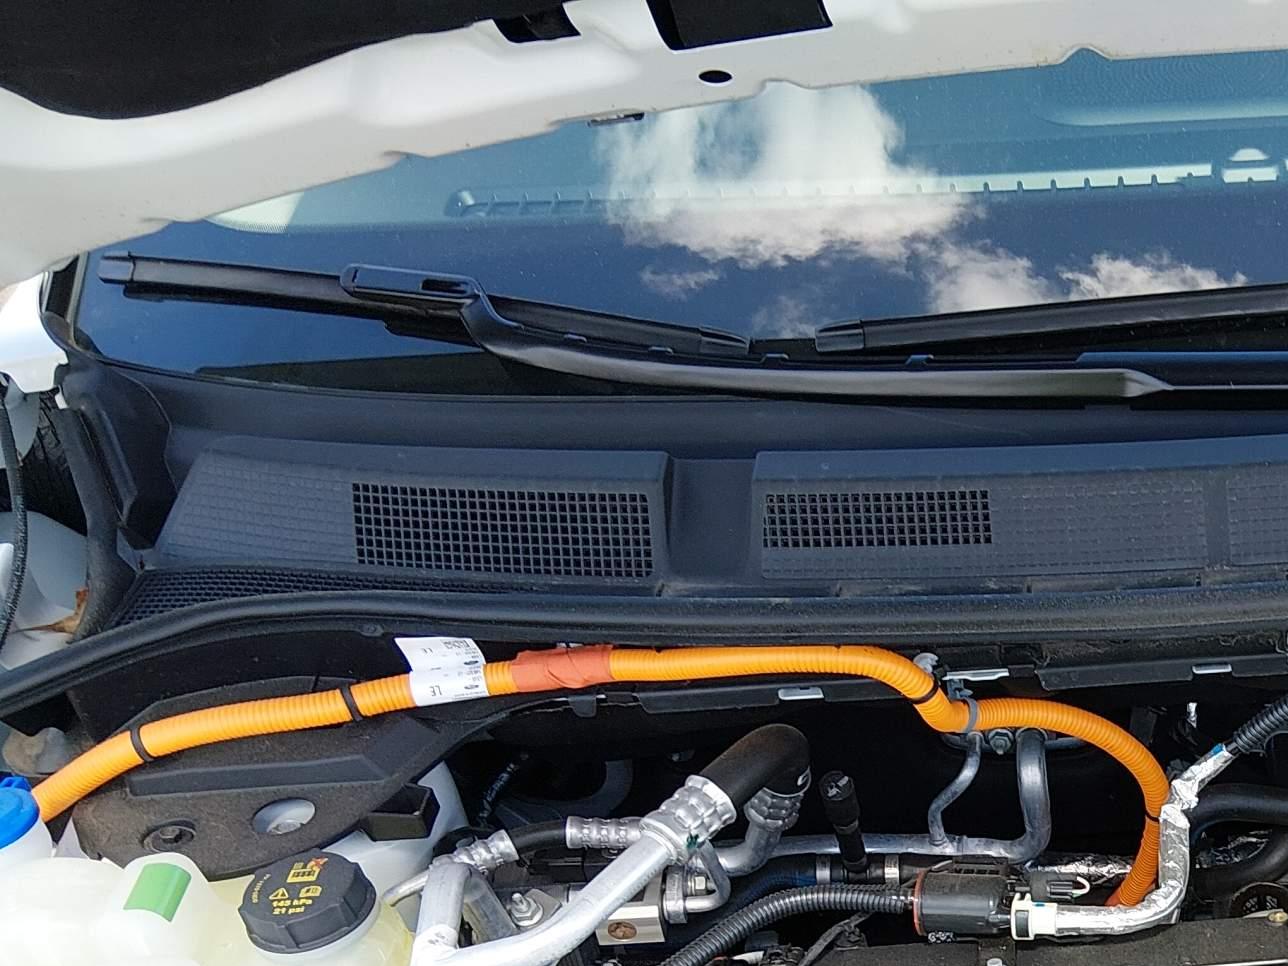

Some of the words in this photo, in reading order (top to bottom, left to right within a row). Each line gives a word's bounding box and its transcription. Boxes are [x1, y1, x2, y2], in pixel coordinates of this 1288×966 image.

[272, 899, 291, 907] 145
[293, 898, 313, 906] hPa
[272, 907, 285, 915] 21
[288, 906, 305, 915] psi
